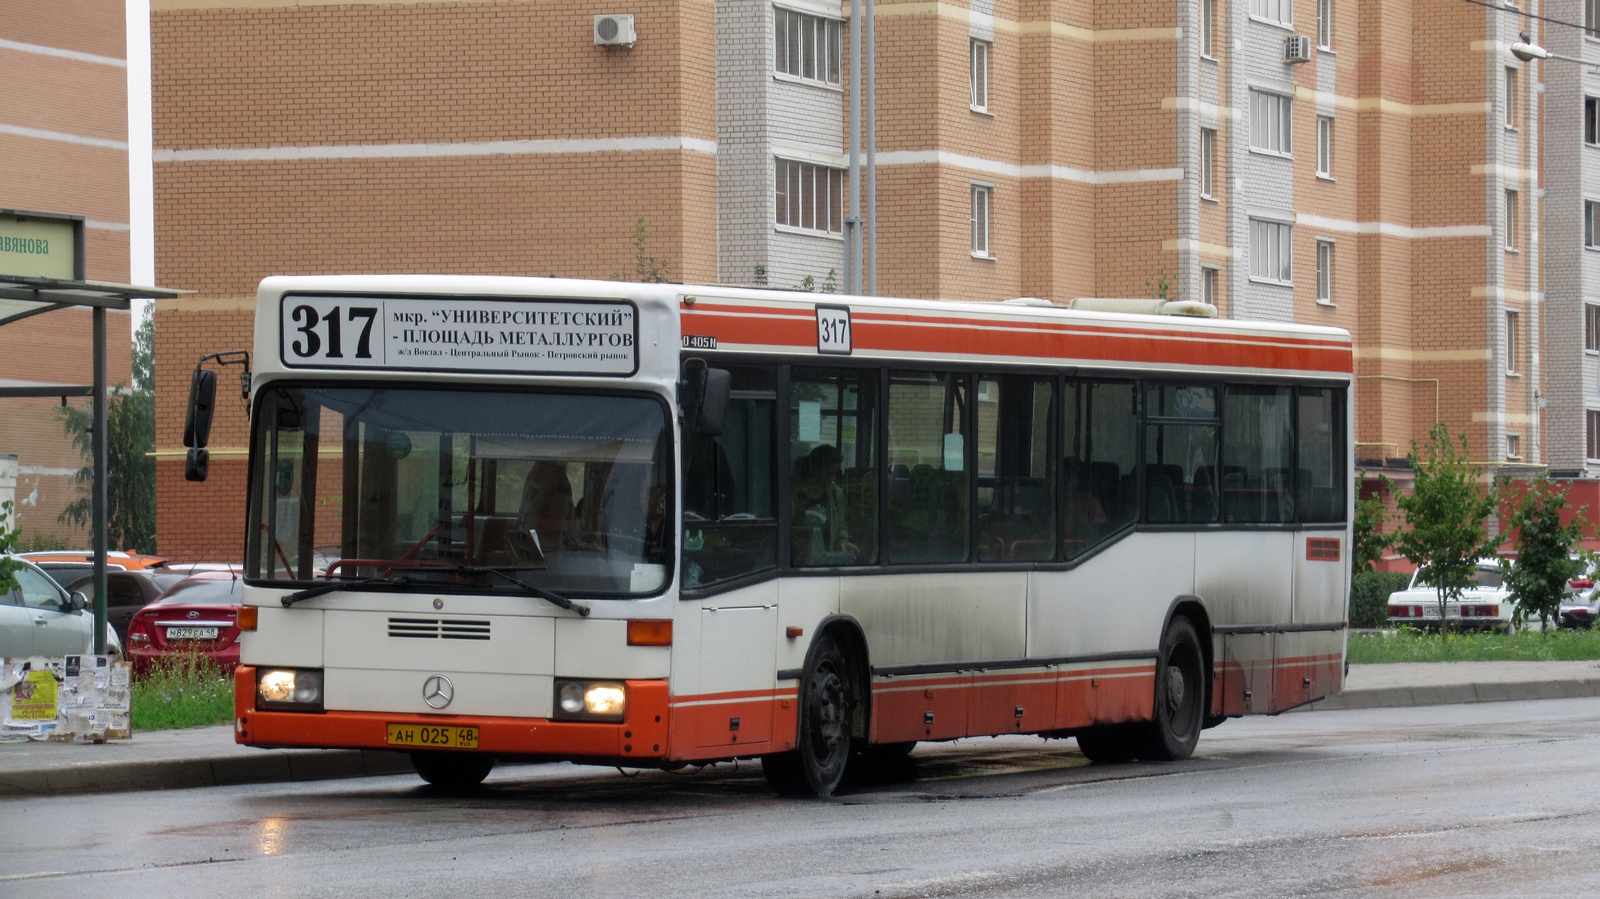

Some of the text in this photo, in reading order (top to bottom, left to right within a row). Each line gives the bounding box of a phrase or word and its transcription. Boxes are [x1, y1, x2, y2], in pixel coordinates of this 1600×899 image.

[393, 312, 427, 326] мкр.
[292, 304, 378, 358] 317
[403, 329, 494, 346] ПЛОЩАДЬ
[499, 331, 633, 347] МЕТАЛЛУРГОВ
[821, 318, 847, 344] 317
[397, 347, 412, 356] ж/д
[414, 348, 442, 356] Вокзал
[450, 348, 509, 359] Центральный
[511, 350, 540, 358] Рынок
[547, 351, 598, 360] Петровский
[601, 352, 629, 361] рынок
[420, 728, 449, 744] 025
[458, 729, 474, 741] 48
